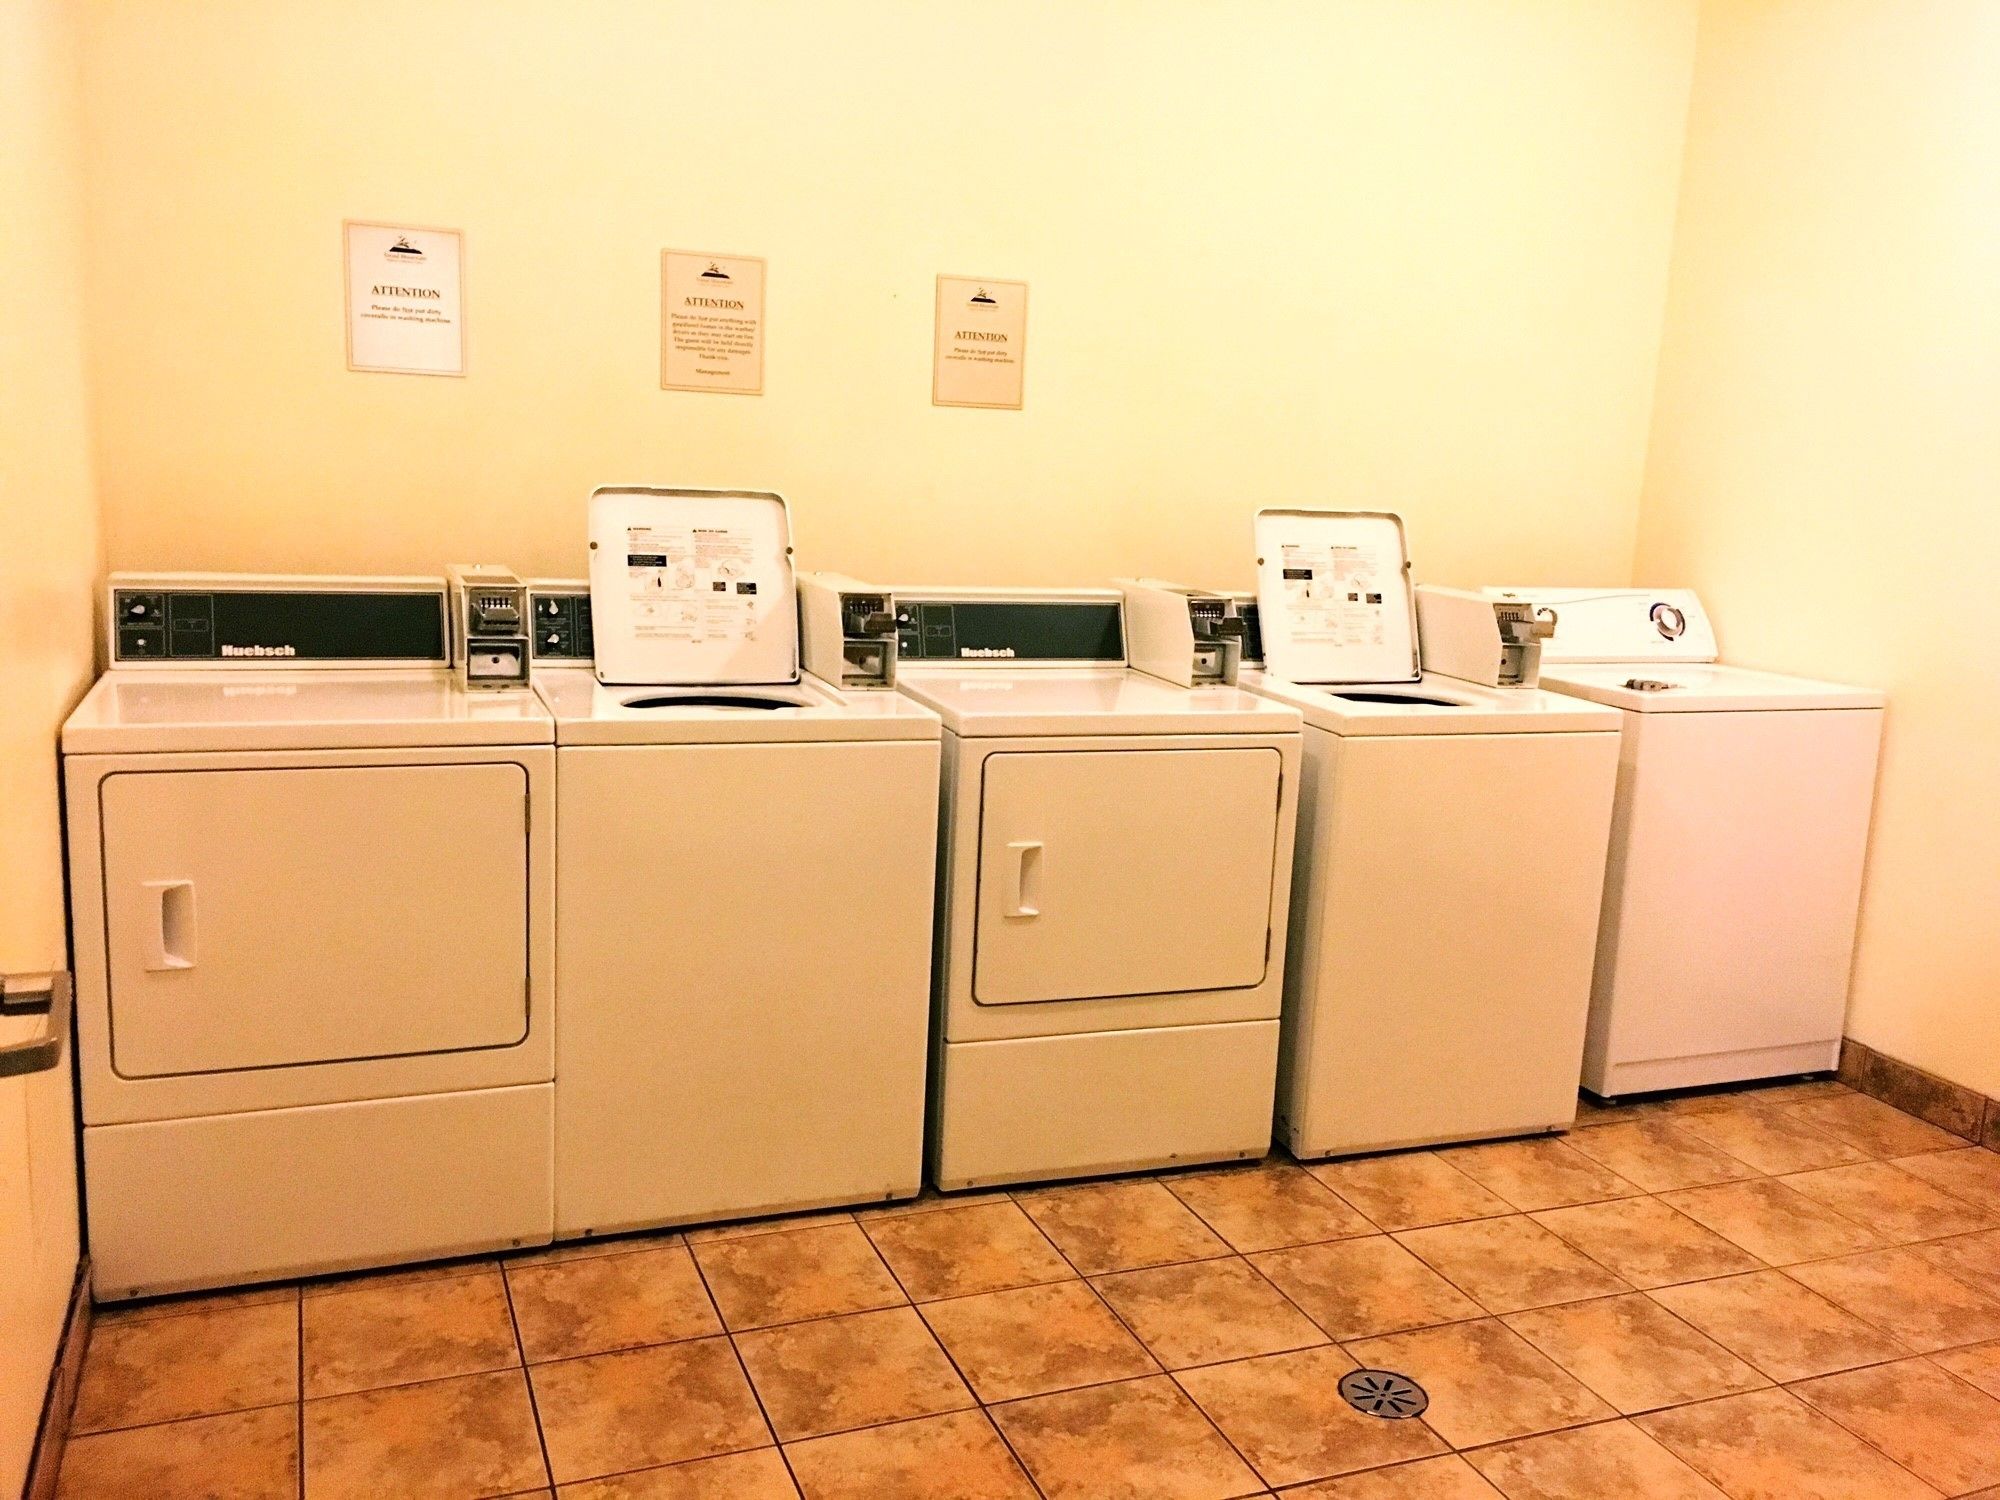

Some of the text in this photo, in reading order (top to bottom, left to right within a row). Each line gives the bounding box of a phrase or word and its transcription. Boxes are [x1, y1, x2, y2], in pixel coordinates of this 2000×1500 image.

[371, 285, 440, 299] ATTENTION
[371, 304, 391, 312] Please
[684, 297, 744, 310] ATTENTION
[398, 315, 423, 323] washing
[955, 330, 1008, 342] ATTENTION
[696, 368, 730, 376] Management
[221, 644, 296, 657] Huebsch
[961, 647, 1015, 657] Huebsch
